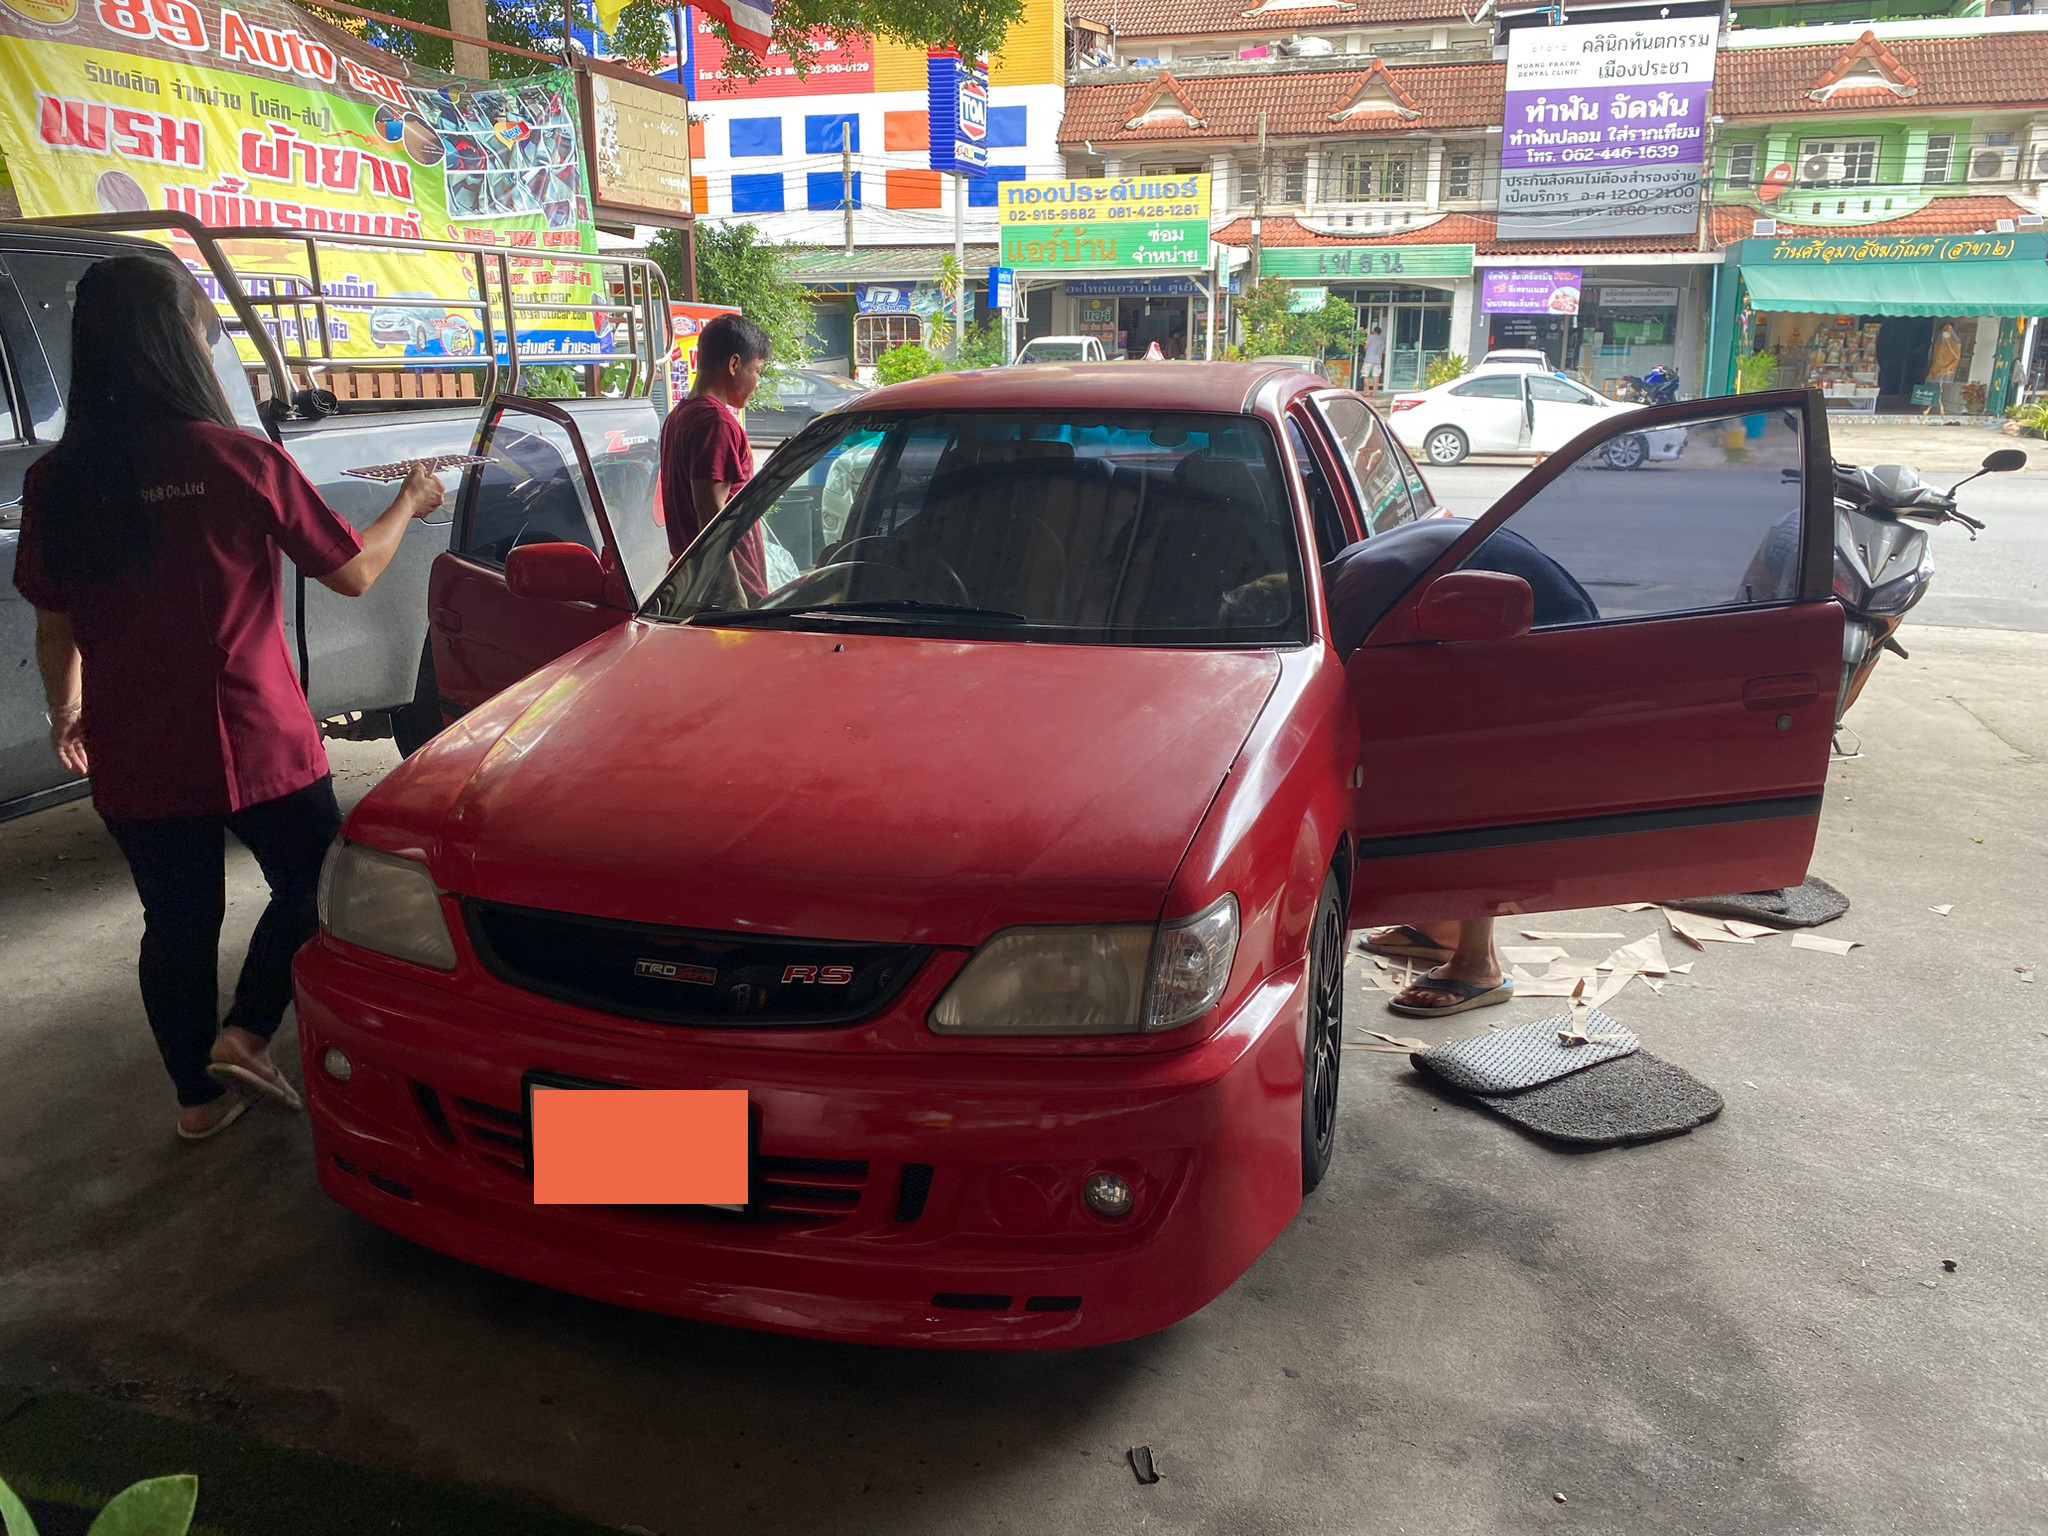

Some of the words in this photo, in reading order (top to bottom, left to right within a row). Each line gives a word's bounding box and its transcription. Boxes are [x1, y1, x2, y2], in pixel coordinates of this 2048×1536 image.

[1583, 32, 1709, 52] คลินิกทันตกรรม
[95, 0, 208, 50] 89
[221, 9, 336, 83] Auto
[342, 57, 411, 108] car
[1518, 70, 1548, 78] DENTAL
[1599, 60, 1689, 78] เมืองประชา
[84, 59, 160, 95] รับผลิต
[170, 77, 241, 111] จำหน่าย
[962, 95, 985, 125] TOA
[1526, 95, 1599, 123] ทำฟัน
[1610, 91, 1689, 119] จัดฟัน
[1510, 128, 1601, 146] ทำฟันปลอม
[1608, 122, 1699, 142] ใส่รากเทียม
[37, 93, 202, 168] พรม
[240, 121, 412, 201] ผ้ายาง
[1527, 149, 1556, 163] โทร.
[1562, 145, 1679, 162] 062-446-1639
[1008, 177, 1198, 204] ทองประดับแอร์
[1506, 190, 1569, 203] เปิดบริการ
[1009, 208, 1096, 221] 02-915-9682
[1008, 226, 1117, 262] แอร์บ้าน
[1148, 223, 1184, 242] ซ่อม
[1132, 247, 1198, 264] จำหน่าย
[1084, 306, 1112, 322] แอร์
[638, 961, 677, 976] TRD
[781, 965, 854, 985] RS
